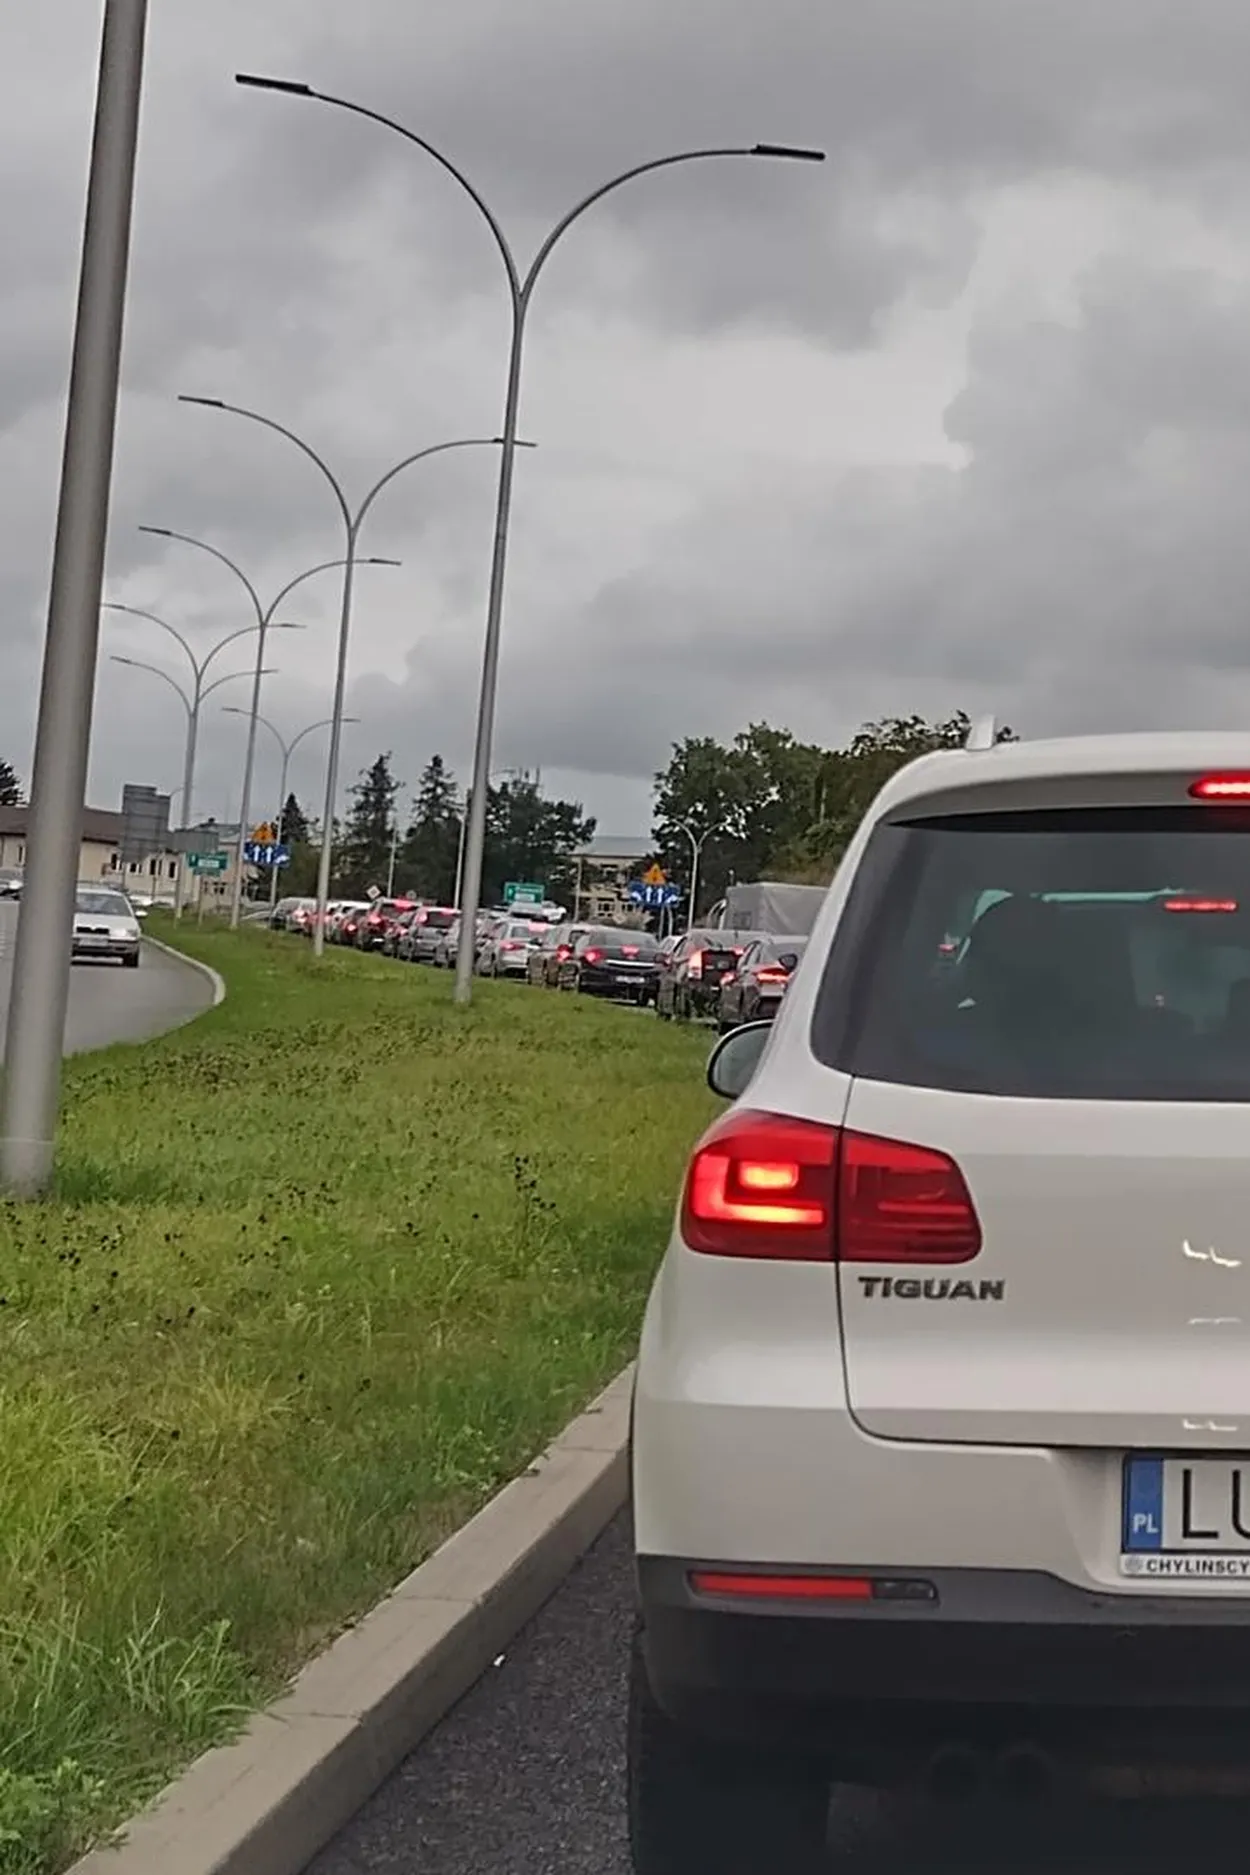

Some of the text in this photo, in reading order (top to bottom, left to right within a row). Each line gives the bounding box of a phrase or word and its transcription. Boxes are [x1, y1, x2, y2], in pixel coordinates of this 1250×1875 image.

[858, 1276, 1005, 1300] TIGUAN
[1132, 1513, 1159, 1534] PL
[1146, 1558, 1250, 1574] CHYLINSCY
